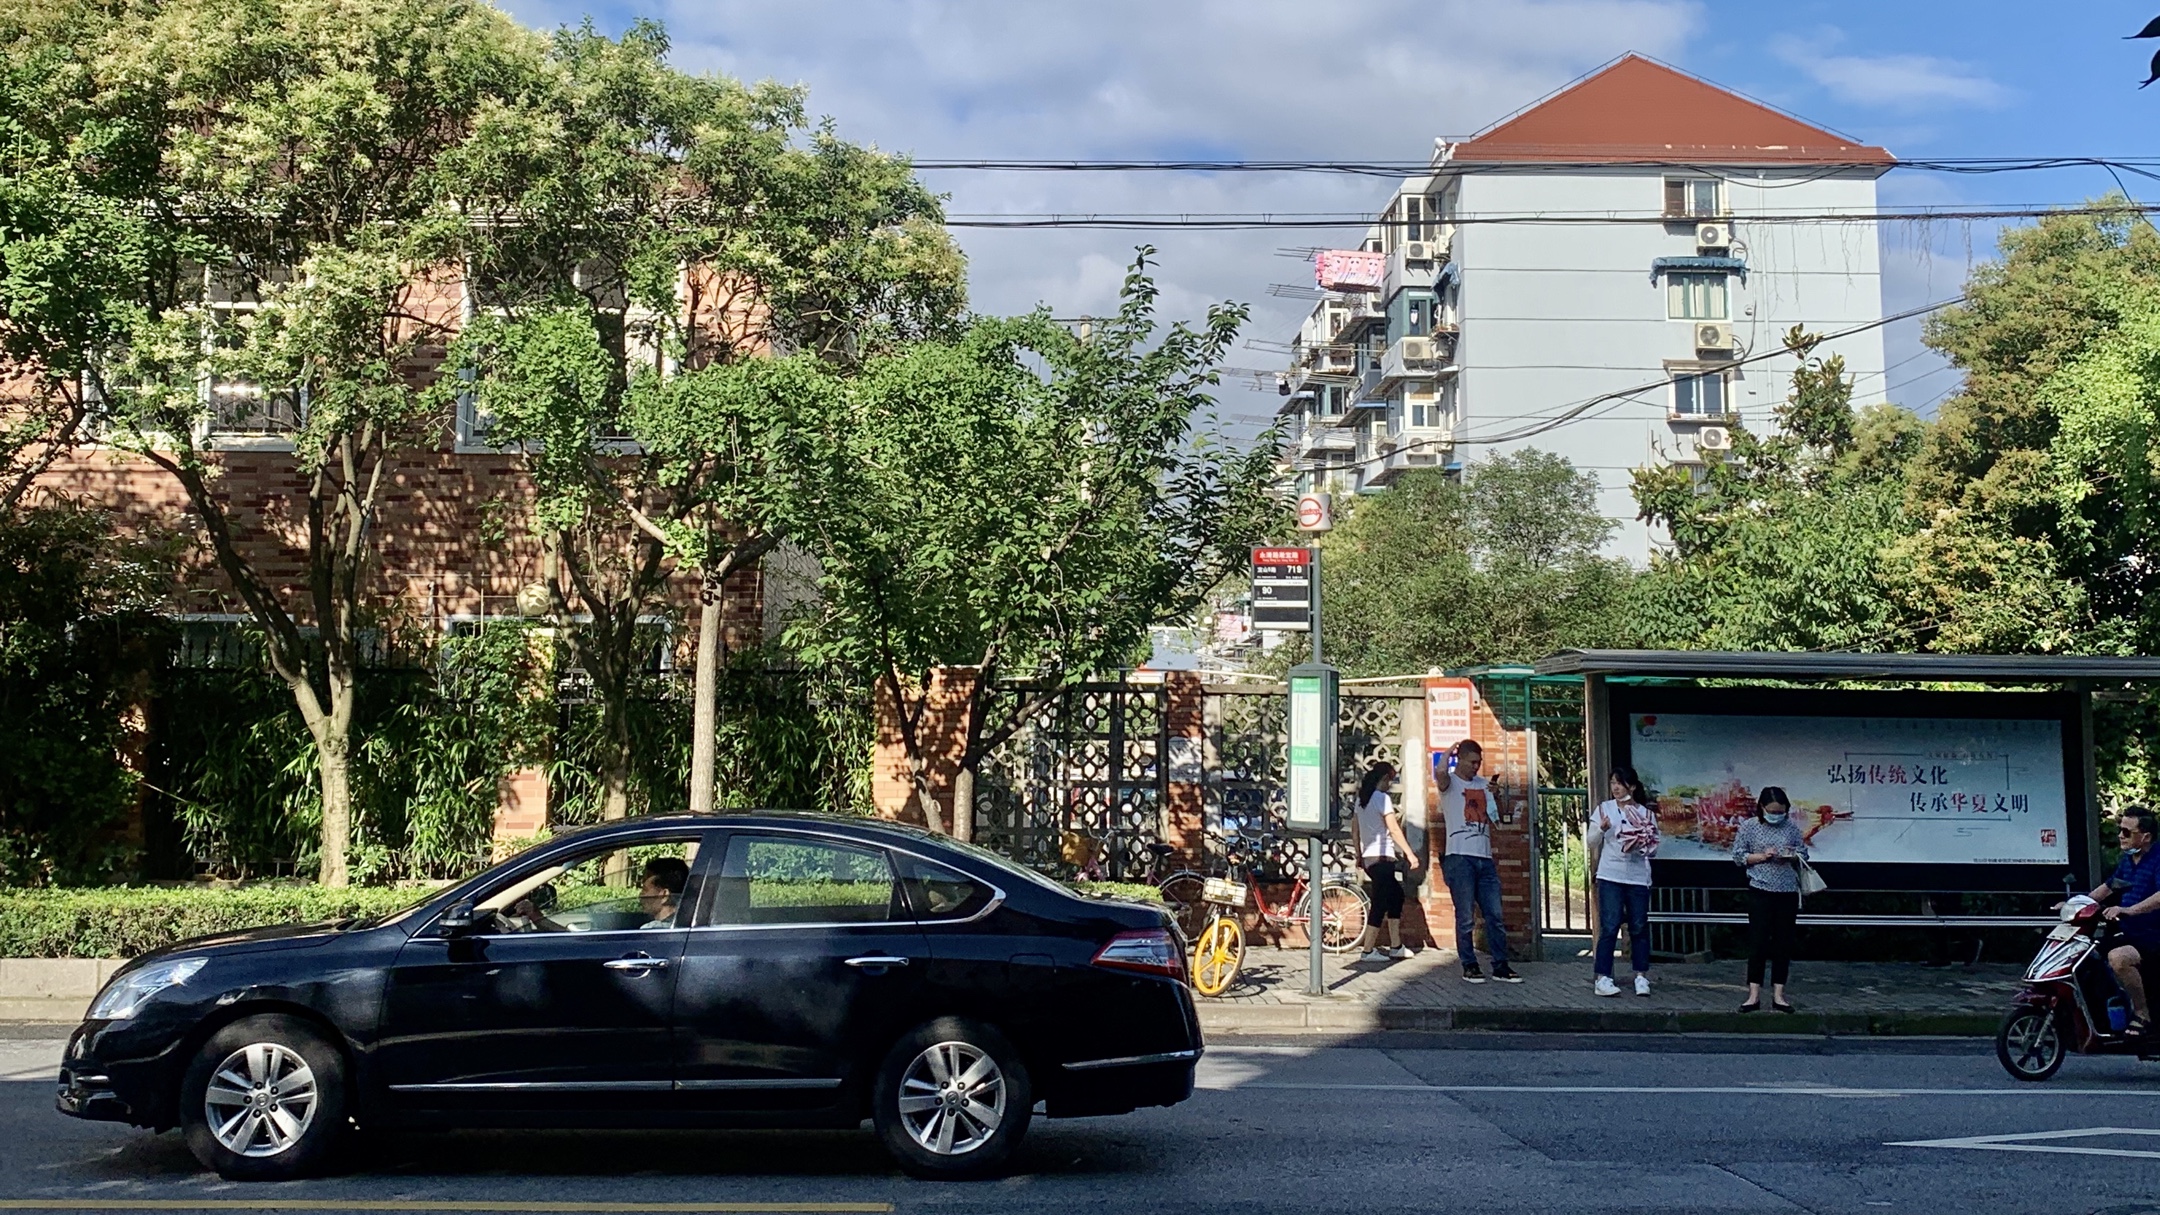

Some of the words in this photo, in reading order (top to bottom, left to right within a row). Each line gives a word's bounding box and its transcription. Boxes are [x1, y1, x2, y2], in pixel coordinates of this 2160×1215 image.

[1262, 586, 1272, 595] 90
[1827, 763, 1949, 785] 弘扬传统文化
[1910, 791, 2029, 814] 传承华夏文明
